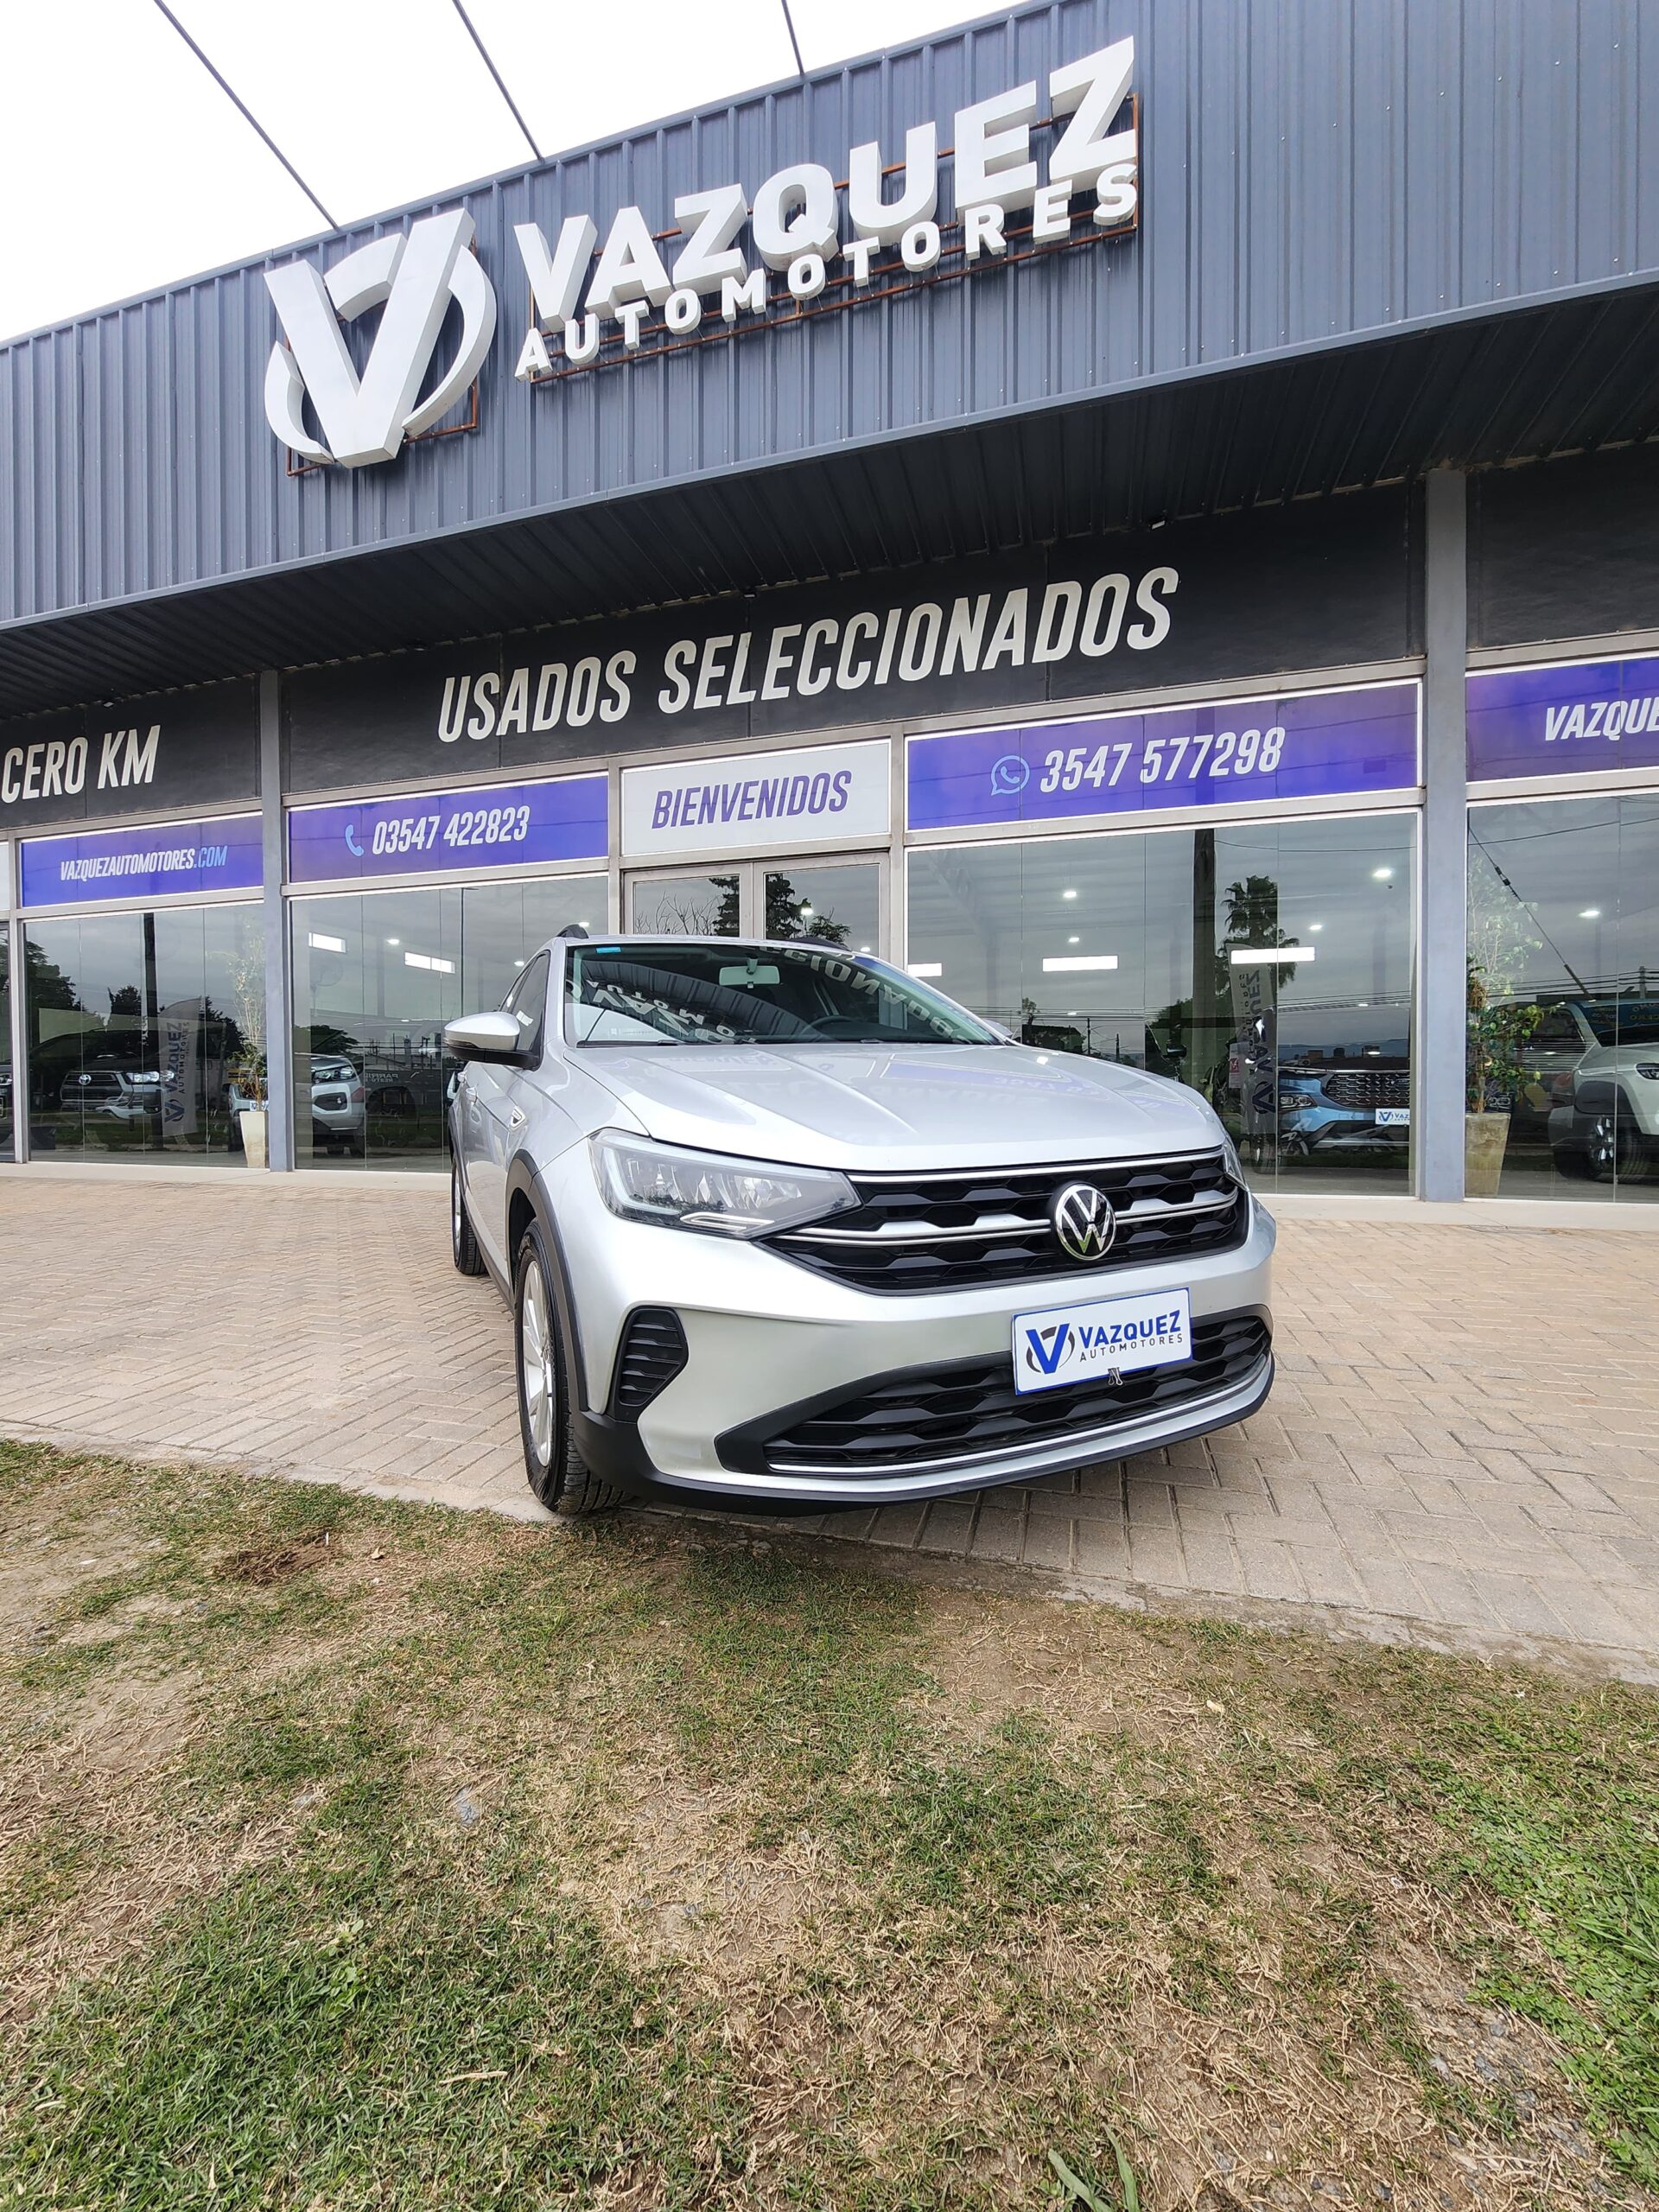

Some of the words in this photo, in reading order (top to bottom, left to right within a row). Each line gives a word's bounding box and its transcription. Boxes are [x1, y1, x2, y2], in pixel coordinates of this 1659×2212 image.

[514, 35, 1136, 332] VAZQUEZ
[514, 163, 1138, 383] AUTOMOTORES
[438, 650, 637, 742] USADOS
[658, 567, 1179, 714] SELECCIONADOS
[1, 736, 89, 804] CERO
[98, 724, 162, 790] KM
[1040, 742, 1133, 793] 3547
[1140, 727, 1286, 784] 577298
[372, 816, 441, 855] 03547
[443, 805, 530, 847] 422823
[652, 770, 852, 830] BIENVENIDOS
[60, 845, 228, 882] VAZQUEZAUTOMOTORES.COM
[1078, 1309, 1181, 1349] VAZQUEZ
[1079, 1333, 1183, 1363] AUTOMOTORES
